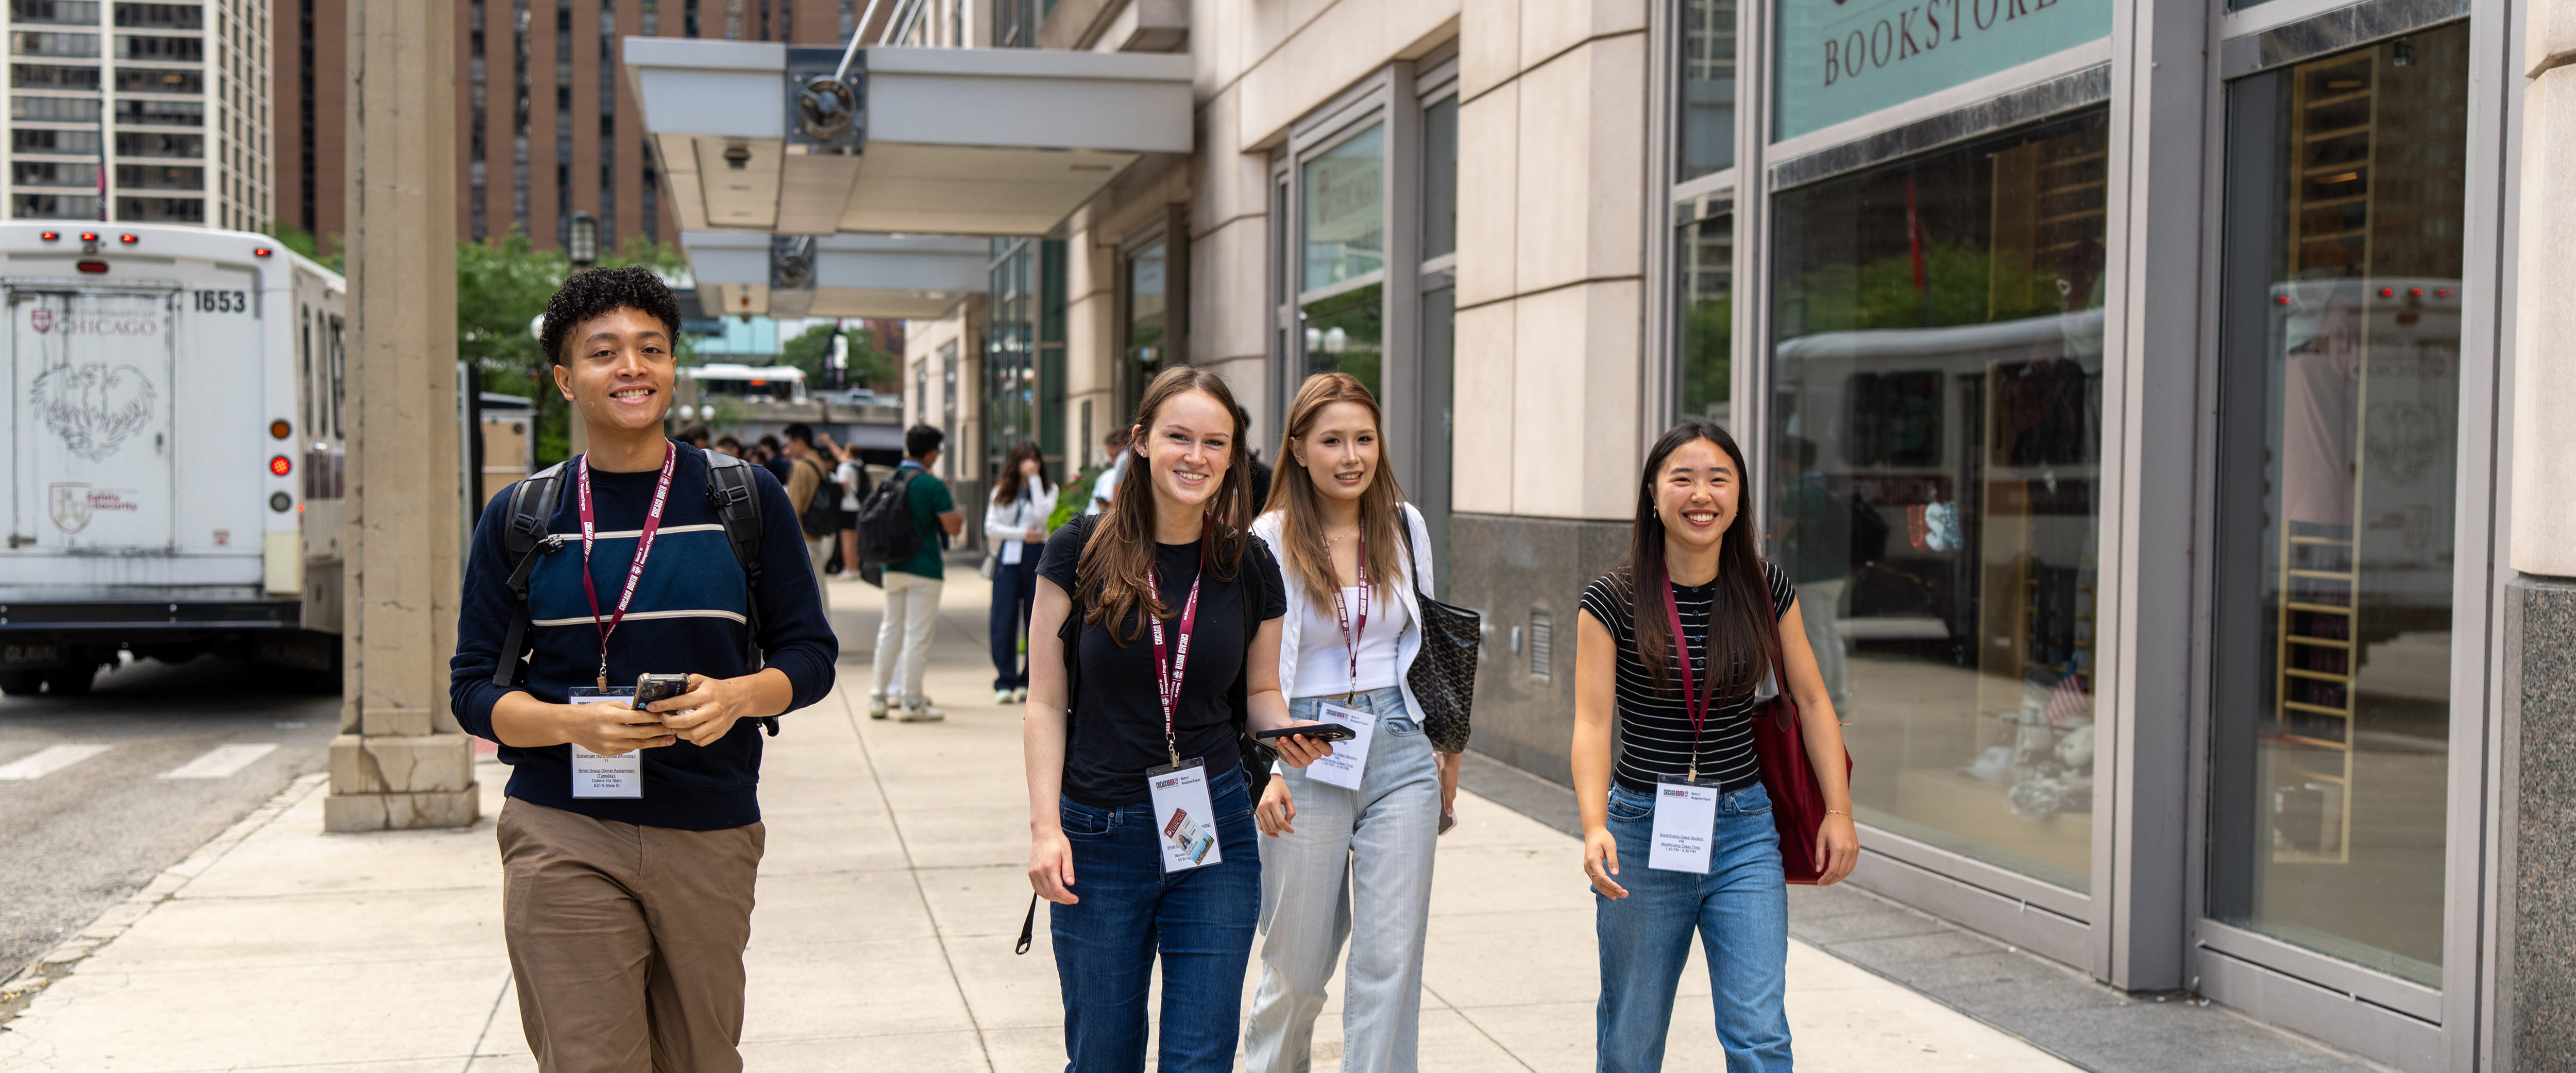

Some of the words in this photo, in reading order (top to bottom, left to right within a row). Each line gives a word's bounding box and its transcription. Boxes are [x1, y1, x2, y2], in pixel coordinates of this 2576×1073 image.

[1823, 0, 2057, 87] BOOKSTO
[194, 291, 246, 313] 1653
[54, 318, 157, 336] CHICAGO
[656, 485, 667, 503] BOOTH
[651, 498, 663, 518] CHICAGO
[584, 521, 593, 539] CHICAGO
[640, 542, 650, 565] Management
[619, 590, 632, 611] CHICAGO
[627, 574, 638, 593] BOOTH
[1335, 592, 1345, 608] CHICAGO
[1151, 613, 1160, 624] BOO
[1153, 625, 1163, 645] CHICAGO
[1178, 633, 1189, 654] CHICAGO
[1175, 654, 1185, 670] BOOTH
[1156, 779, 1167, 789] CHICAGO
[1166, 778, 1175, 787] BOOTH
[1171, 811, 1186, 833] CHICAGO
